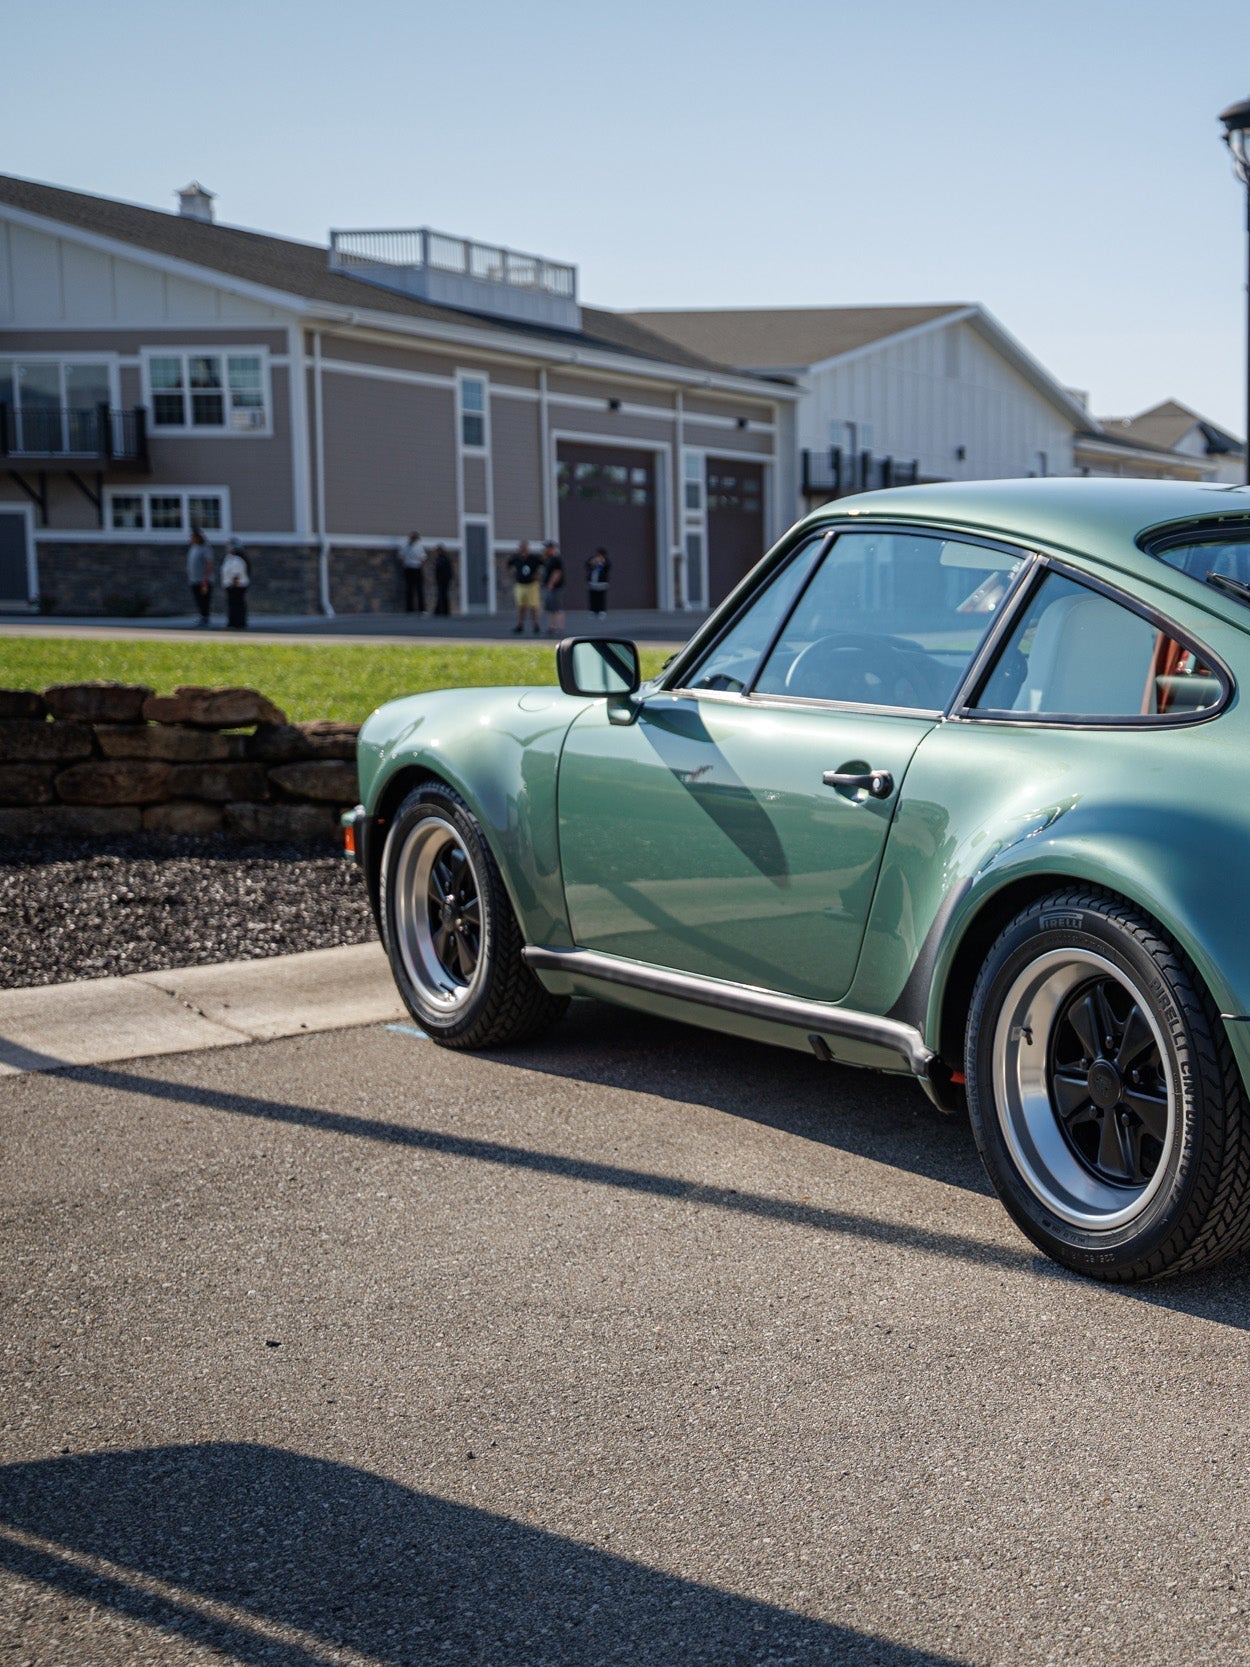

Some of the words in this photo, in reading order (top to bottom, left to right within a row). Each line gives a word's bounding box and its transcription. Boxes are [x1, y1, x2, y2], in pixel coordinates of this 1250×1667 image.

[1039, 912, 1084, 931] PIRELLI
[1151, 976, 1189, 1052] PIRELLI
[1178, 1061, 1195, 1178] CINTURATO
